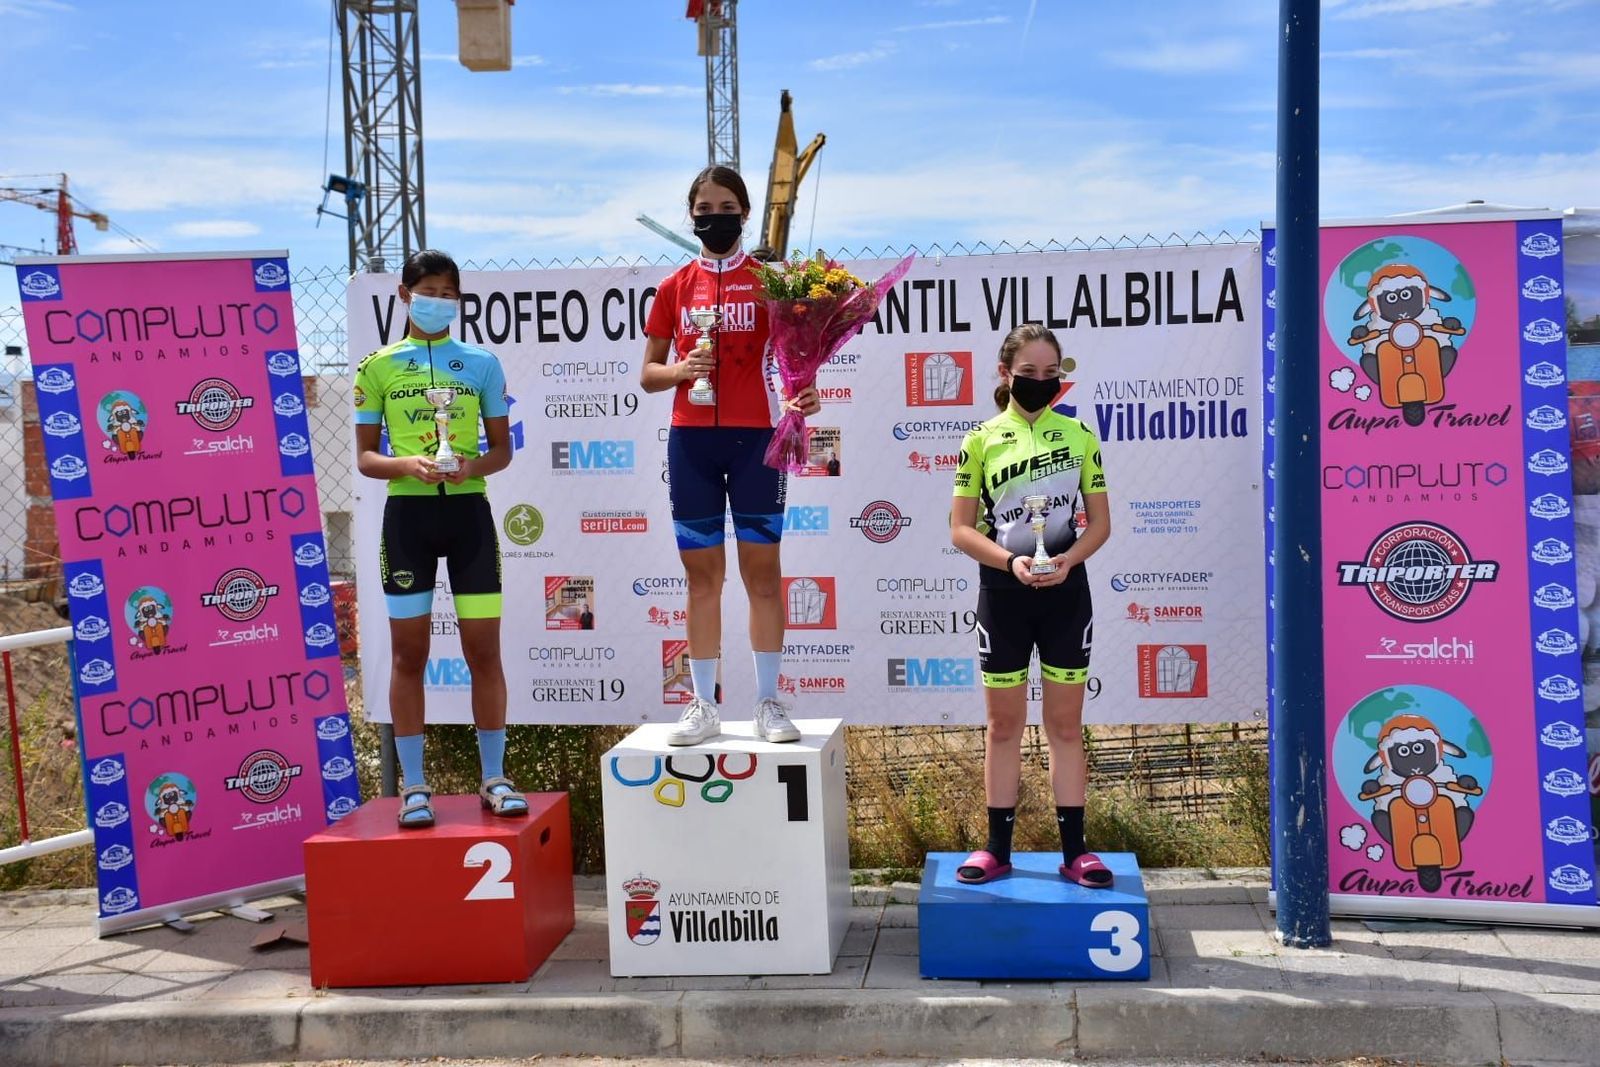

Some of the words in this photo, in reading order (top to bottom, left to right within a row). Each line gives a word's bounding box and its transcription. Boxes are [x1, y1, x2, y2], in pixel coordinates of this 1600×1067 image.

[460, 289, 590, 345] ROFEO
[856, 279, 971, 335] ANTIL
[981, 267, 1244, 332] VILLALBILLA
[45, 303, 279, 344] COMPLUTO
[90, 344, 250, 364] ANDAMIOS
[542, 361, 628, 377] COMPLUTO
[545, 393, 609, 402] RESTAURANTE
[1094, 377, 1219, 400] AYUNTAMIENTO
[1225, 377, 1245, 396] DE
[177, 398, 253, 414] TRIPORTER
[545, 403, 608, 418] GREEN
[611, 393, 639, 417] 19
[1095, 400, 1248, 442] Villalbilla
[1328, 407, 1402, 436] Aupa
[1426, 404, 1512, 430] Travel
[1030, 455, 1084, 482] BIKES
[1323, 462, 1508, 490] COMPLUTO
[1130, 500, 1201, 509] TRANSPORTES
[1352, 492, 1478, 503] ANDAMIOS
[75, 486, 305, 541] COMPLUTO
[635, 510, 646, 519] by
[1184, 525, 1198, 533] 101
[117, 529, 275, 558] ANDAMIOS
[1340, 563, 1496, 583] TRIPORTER
[202, 586, 278, 606] TRIPORTER
[876, 578, 968, 592] COMPLUTO
[1154, 606, 1202, 617] SANFOR
[1379, 589, 1460, 616] TRANSPORTISTAS
[880, 611, 947, 619] RESTAURANTE
[880, 620, 946, 635] GREEN
[950, 610, 977, 635] 19
[529, 647, 615, 661] COMPLUTO
[781, 644, 850, 655] ORTYFADER
[1403, 637, 1474, 659] salchi
[532, 679, 596, 687] RESTAURANTE
[532, 687, 595, 702] GREEN
[597, 678, 625, 702] 19
[799, 677, 845, 688] SANFOR
[100, 670, 330, 736] COMPLUTO
[140, 713, 300, 750] ANDAMIOS
[226, 766, 301, 789] TRIPORTER
[778, 765, 808, 821] 1
[463, 841, 515, 901] 2
[1339, 869, 1418, 900] Aupa
[1444, 870, 1534, 898] Travel
[668, 891, 761, 906] AYUNTAMIENTO
[765, 891, 780, 904] DE
[670, 910, 779, 943] Villalbilla
[1088, 910, 1143, 972] 3
